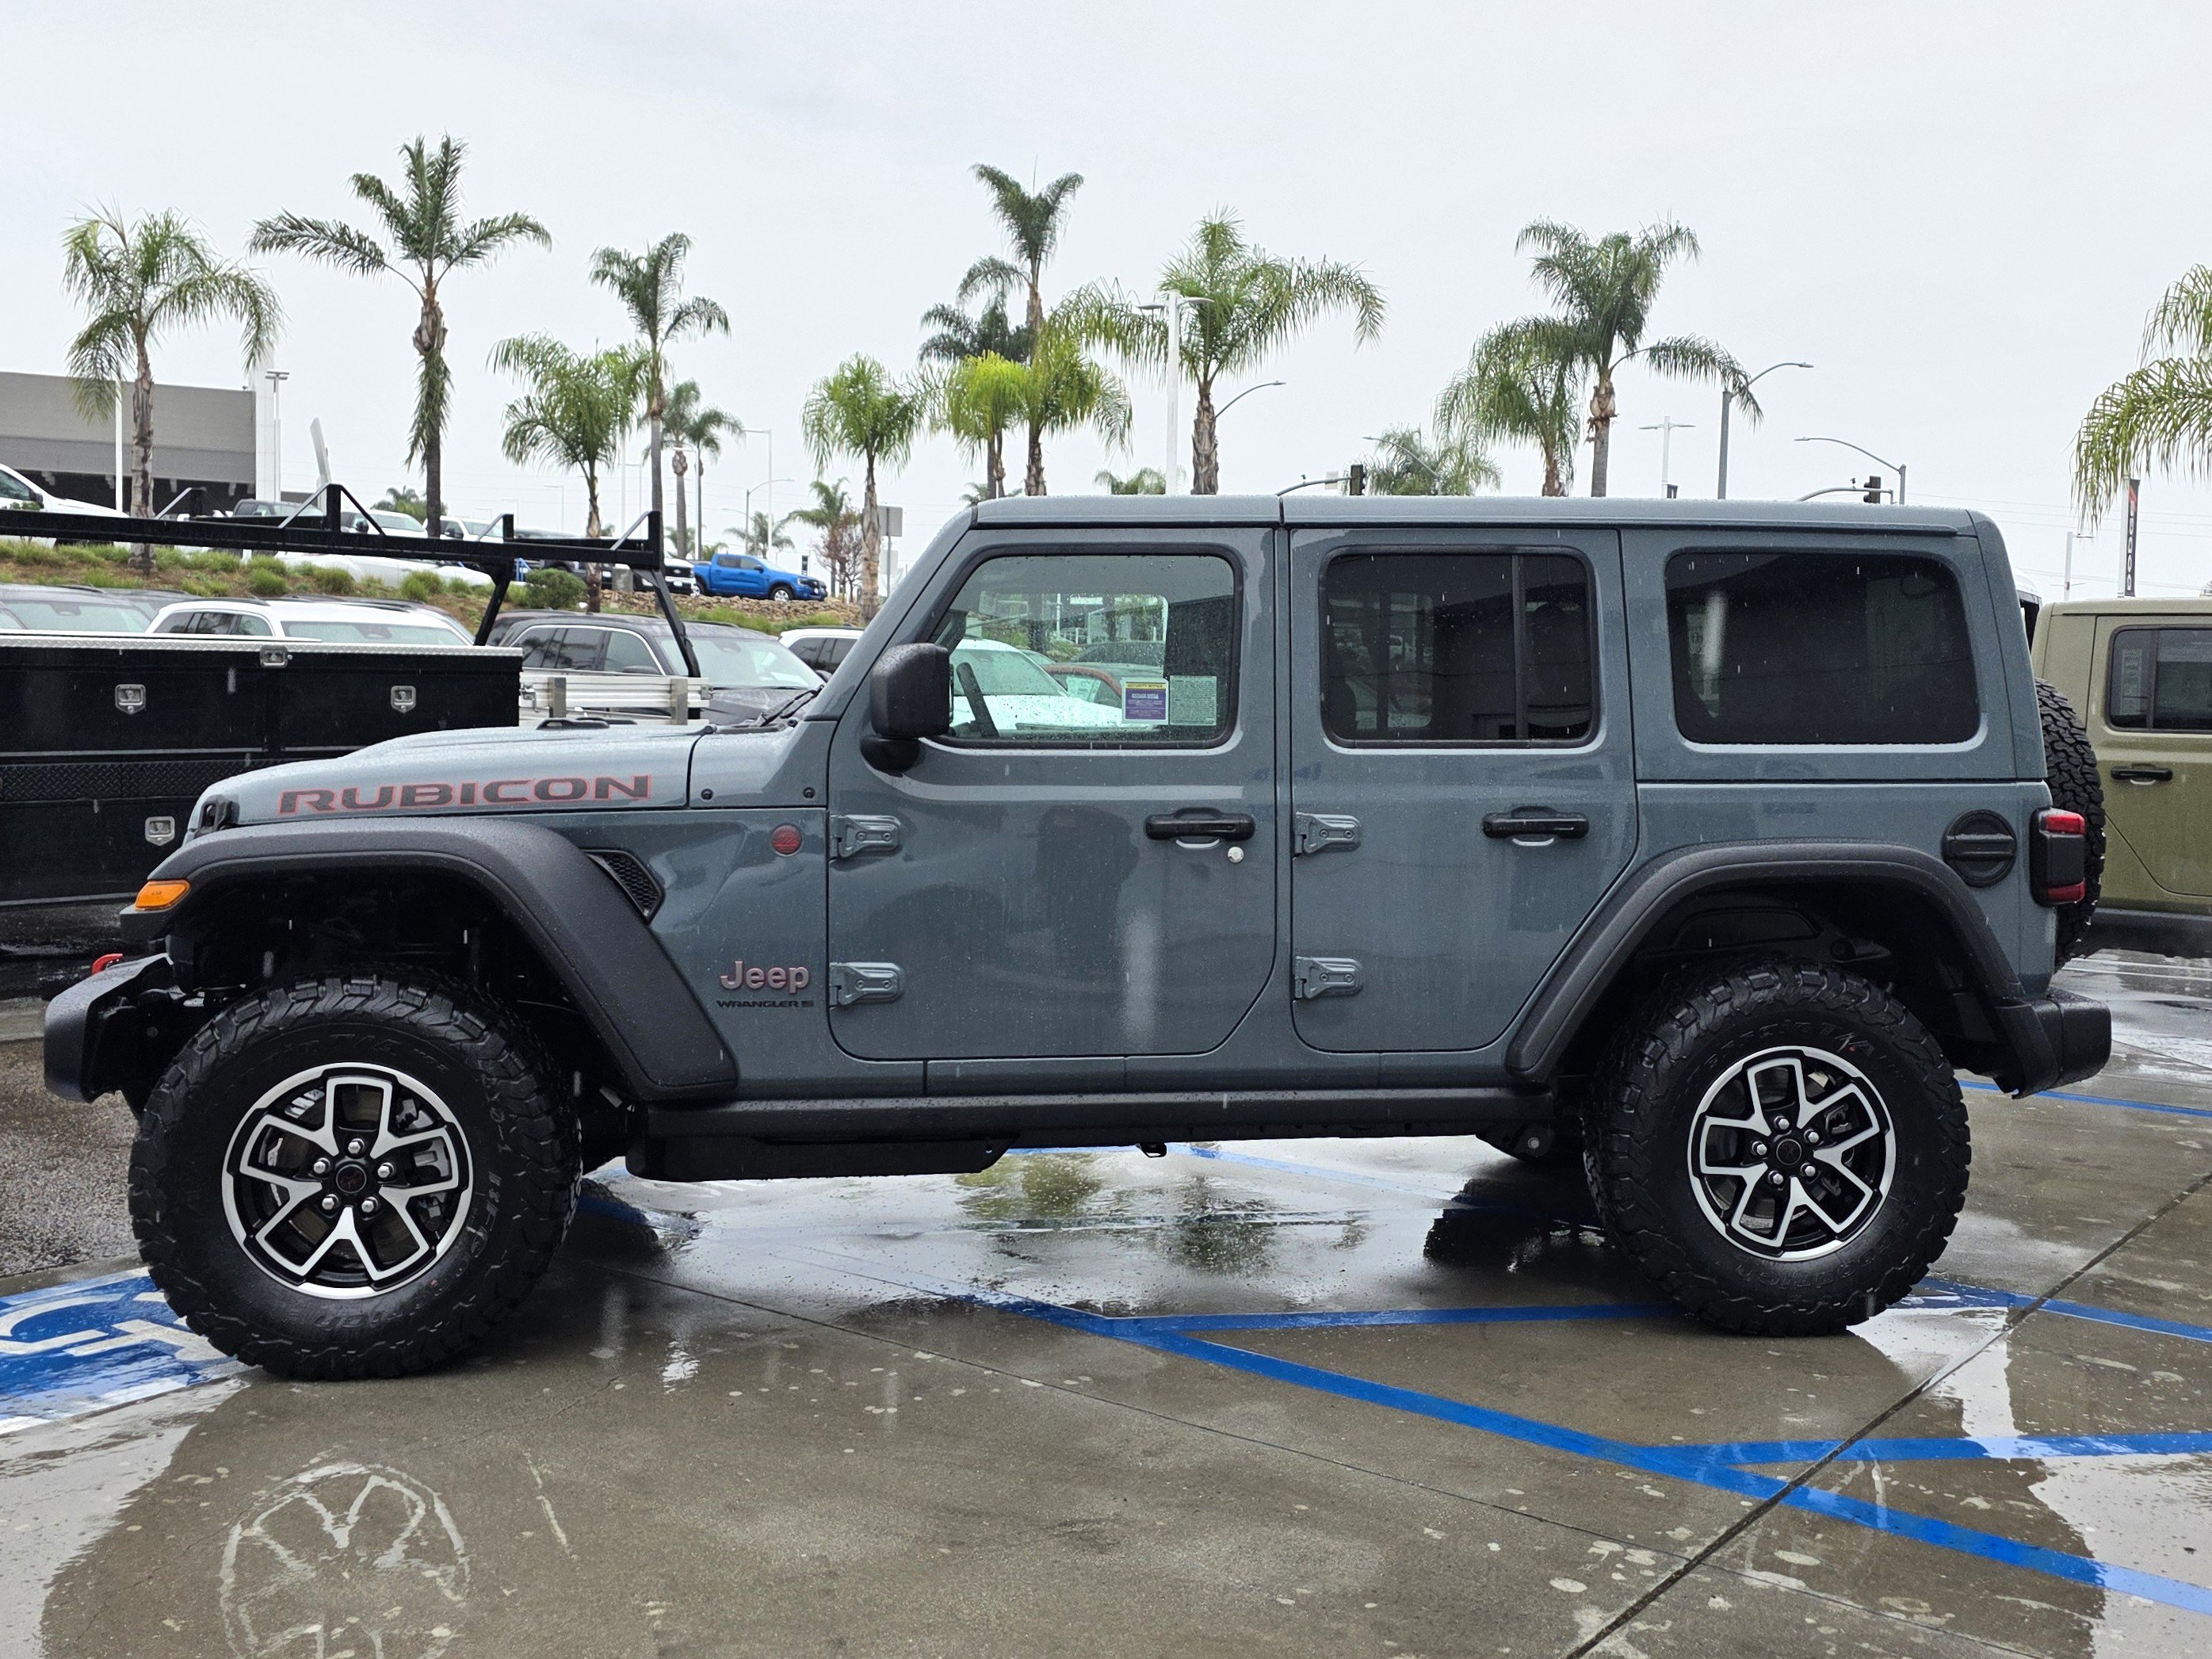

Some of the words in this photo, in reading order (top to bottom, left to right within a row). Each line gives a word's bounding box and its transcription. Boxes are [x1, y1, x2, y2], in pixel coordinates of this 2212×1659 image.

[279, 775, 651, 814] RUBICON
[720, 960, 809, 994] Jeep
[716, 1000, 799, 1008] WRANGLER
